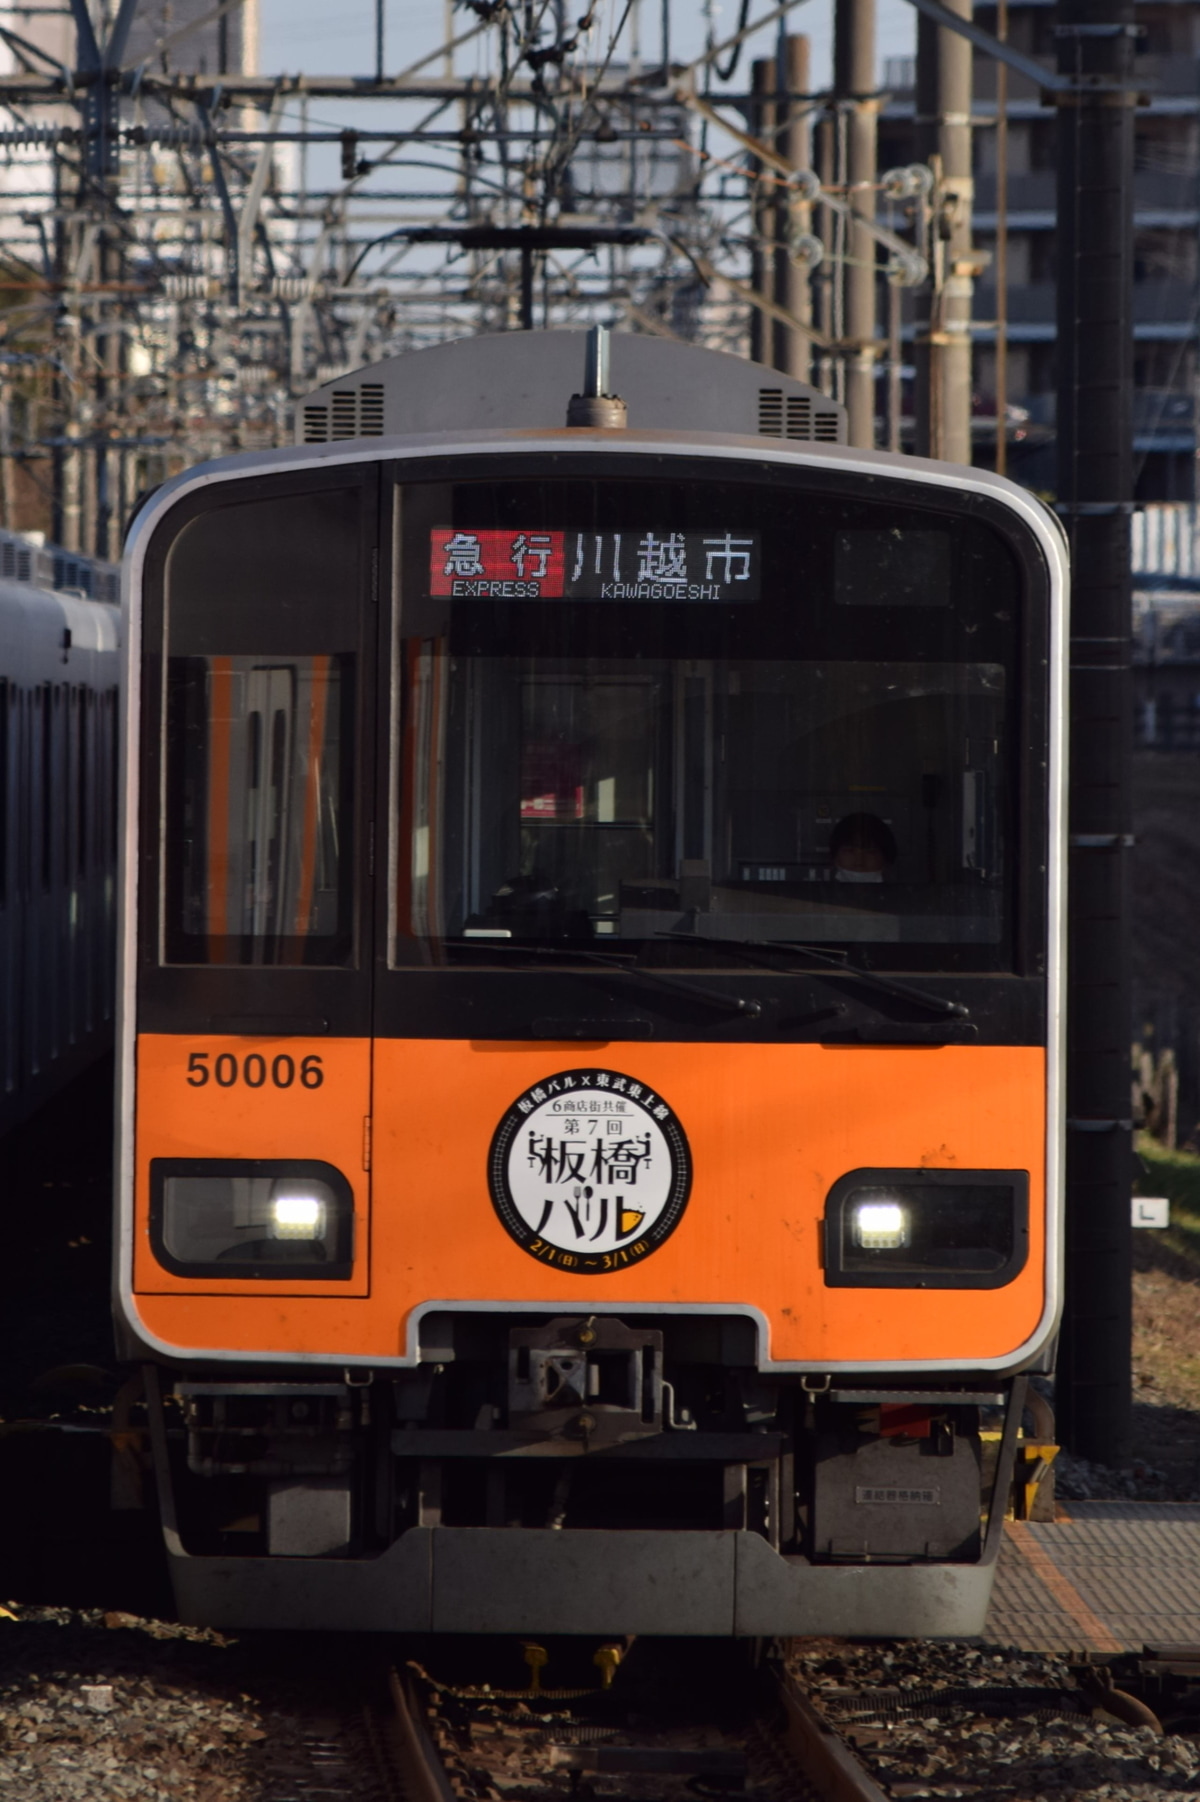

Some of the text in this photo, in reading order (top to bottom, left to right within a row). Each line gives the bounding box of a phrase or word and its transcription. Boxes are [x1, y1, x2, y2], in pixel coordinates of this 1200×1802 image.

[444, 532, 552, 577] 急行
[572, 532, 754, 584] 川越市
[452, 581, 540, 598] EXPRESS
[601, 583, 721, 600] KAWAGOESHI
[186, 1052, 324, 1090] 50006
[564, 1118, 623, 1136] 第7回
[538, 1136, 641, 1185] 板橋
[536, 1186, 647, 1242] バル
